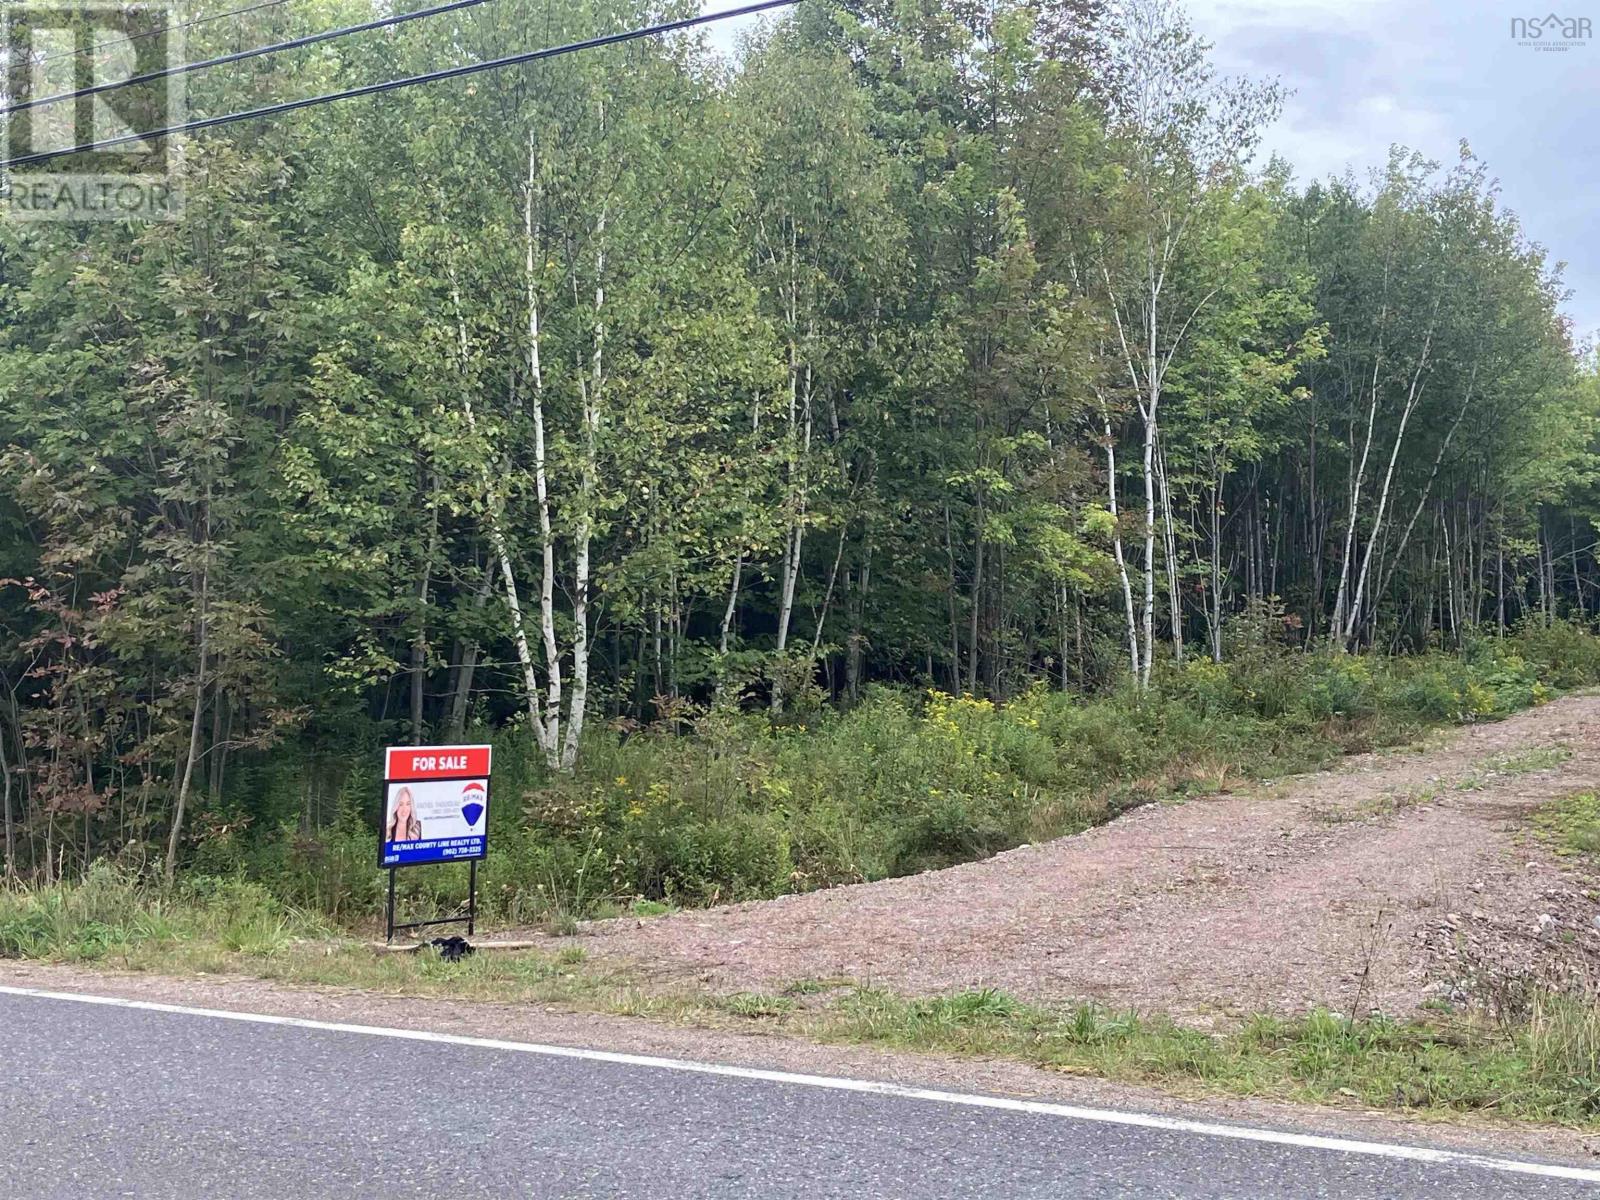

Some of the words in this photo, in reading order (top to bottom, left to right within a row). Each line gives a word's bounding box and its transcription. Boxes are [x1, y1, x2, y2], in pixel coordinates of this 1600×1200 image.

[412, 757, 436, 771] FOR
[438, 756, 468, 770] SALE
[450, 839, 470, 847] REALTY
